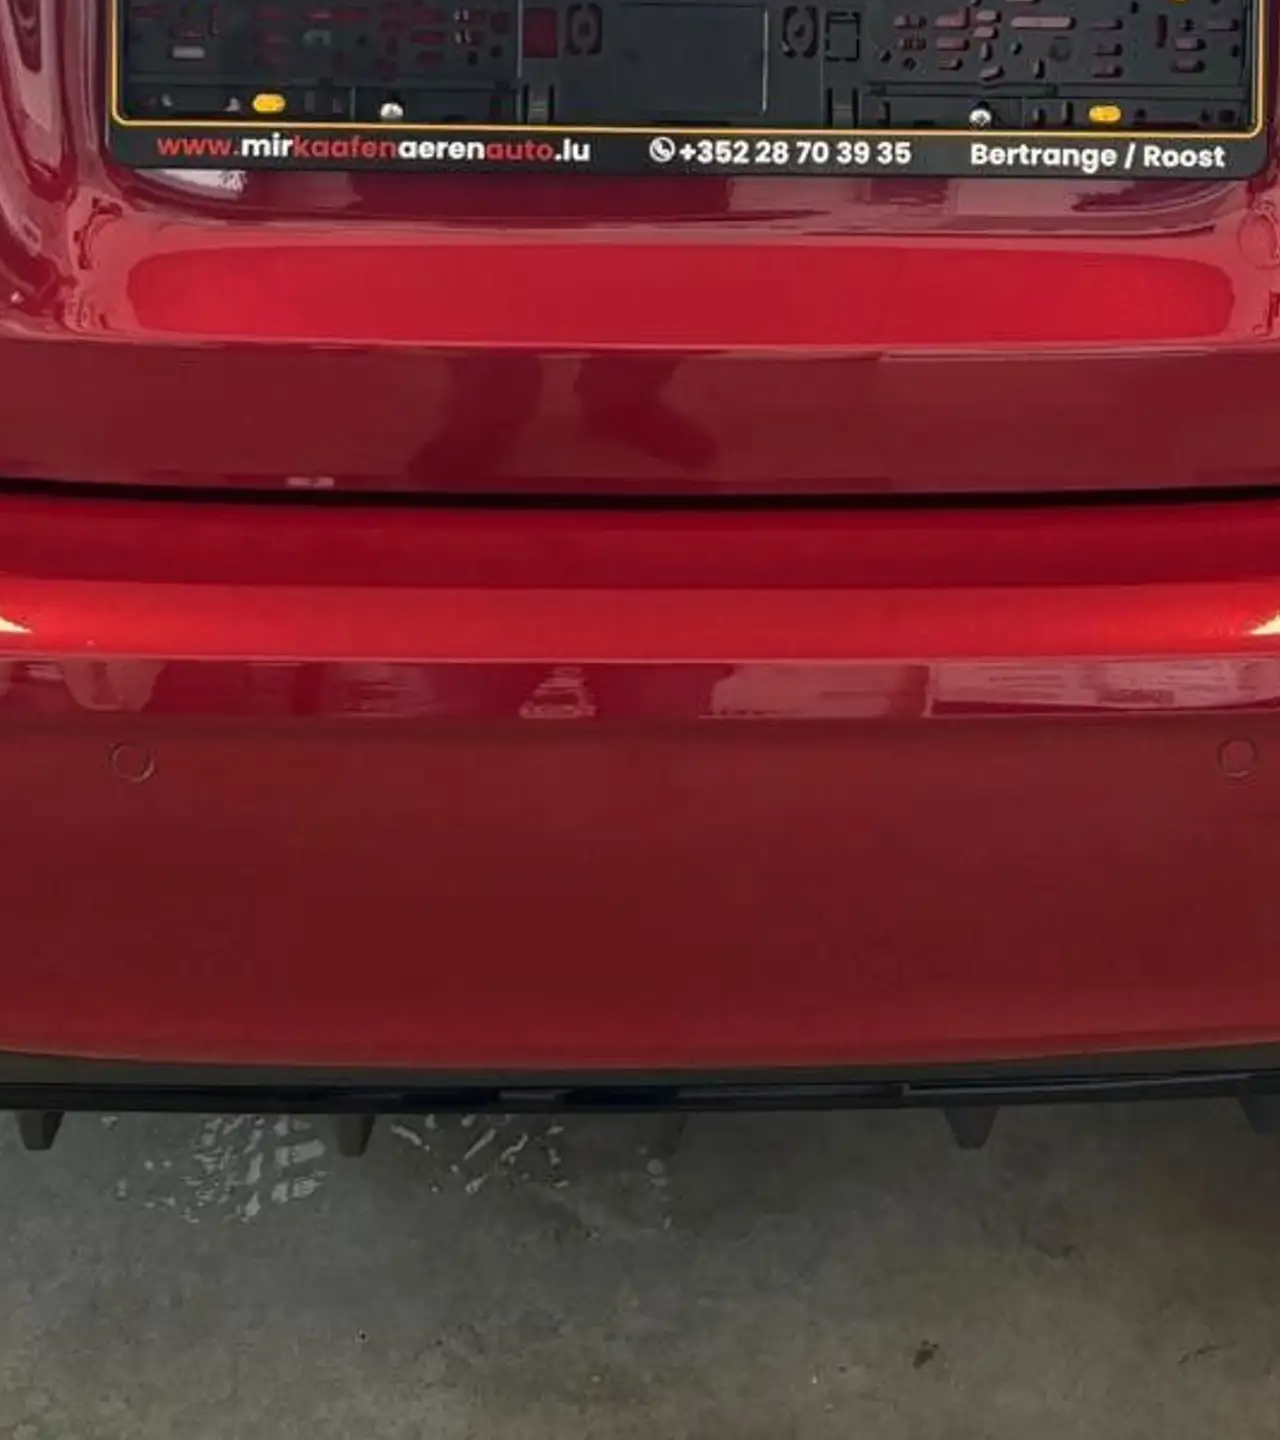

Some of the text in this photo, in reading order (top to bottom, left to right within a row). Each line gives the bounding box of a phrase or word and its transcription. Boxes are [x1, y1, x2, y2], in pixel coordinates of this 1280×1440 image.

[157, 133, 591, 162] www.mirkaafenaerenauto.lu
[680, 140, 912, 165] +352 28 70 39 35
[970, 142, 1225, 174] Bertrange / Roost
